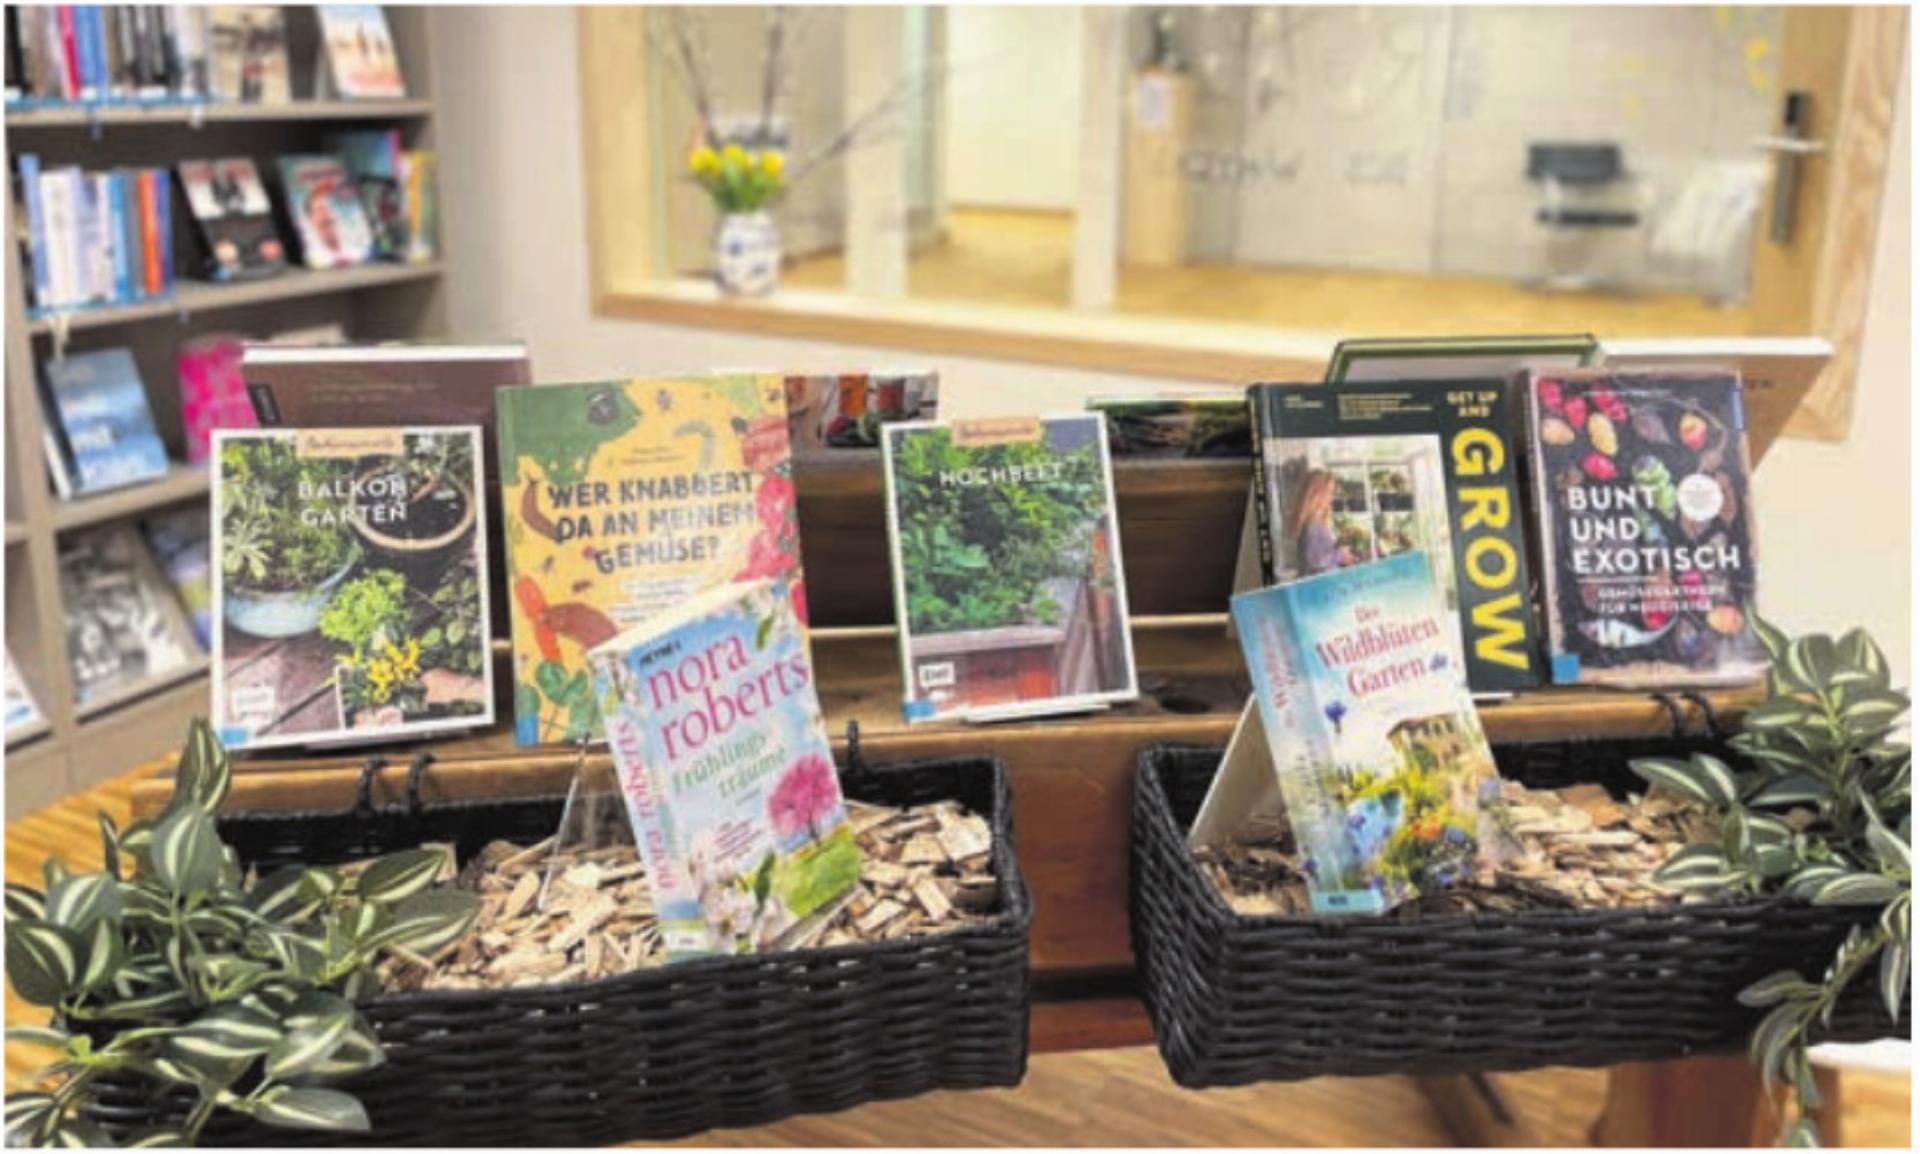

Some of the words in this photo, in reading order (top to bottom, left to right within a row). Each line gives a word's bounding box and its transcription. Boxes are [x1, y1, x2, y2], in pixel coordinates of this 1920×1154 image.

[1446, 391, 1473, 404] GET
[1478, 391, 1498, 402] UP
[1459, 407, 1490, 417] AND
[549, 481, 611, 509] WER
[619, 471, 753, 502] KNABBERT
[939, 462, 1064, 487] HOCHBEET
[300, 502, 407, 526] GARTEN
[1567, 486, 1659, 511] BUNT
[556, 516, 594, 544] DA
[602, 511, 638, 537] AN
[650, 502, 755, 533] MEINEM
[1569, 517, 1640, 541] UND
[595, 536, 720, 574] GEMÜSE?
[1452, 427, 1529, 670] GROW
[1573, 545, 1740, 574] EXOTISCH
[1315, 617, 1439, 669] Wildblüten
[647, 633, 749, 710] nora
[1347, 656, 1426, 700] Garten
[660, 652, 811, 761] roberts
